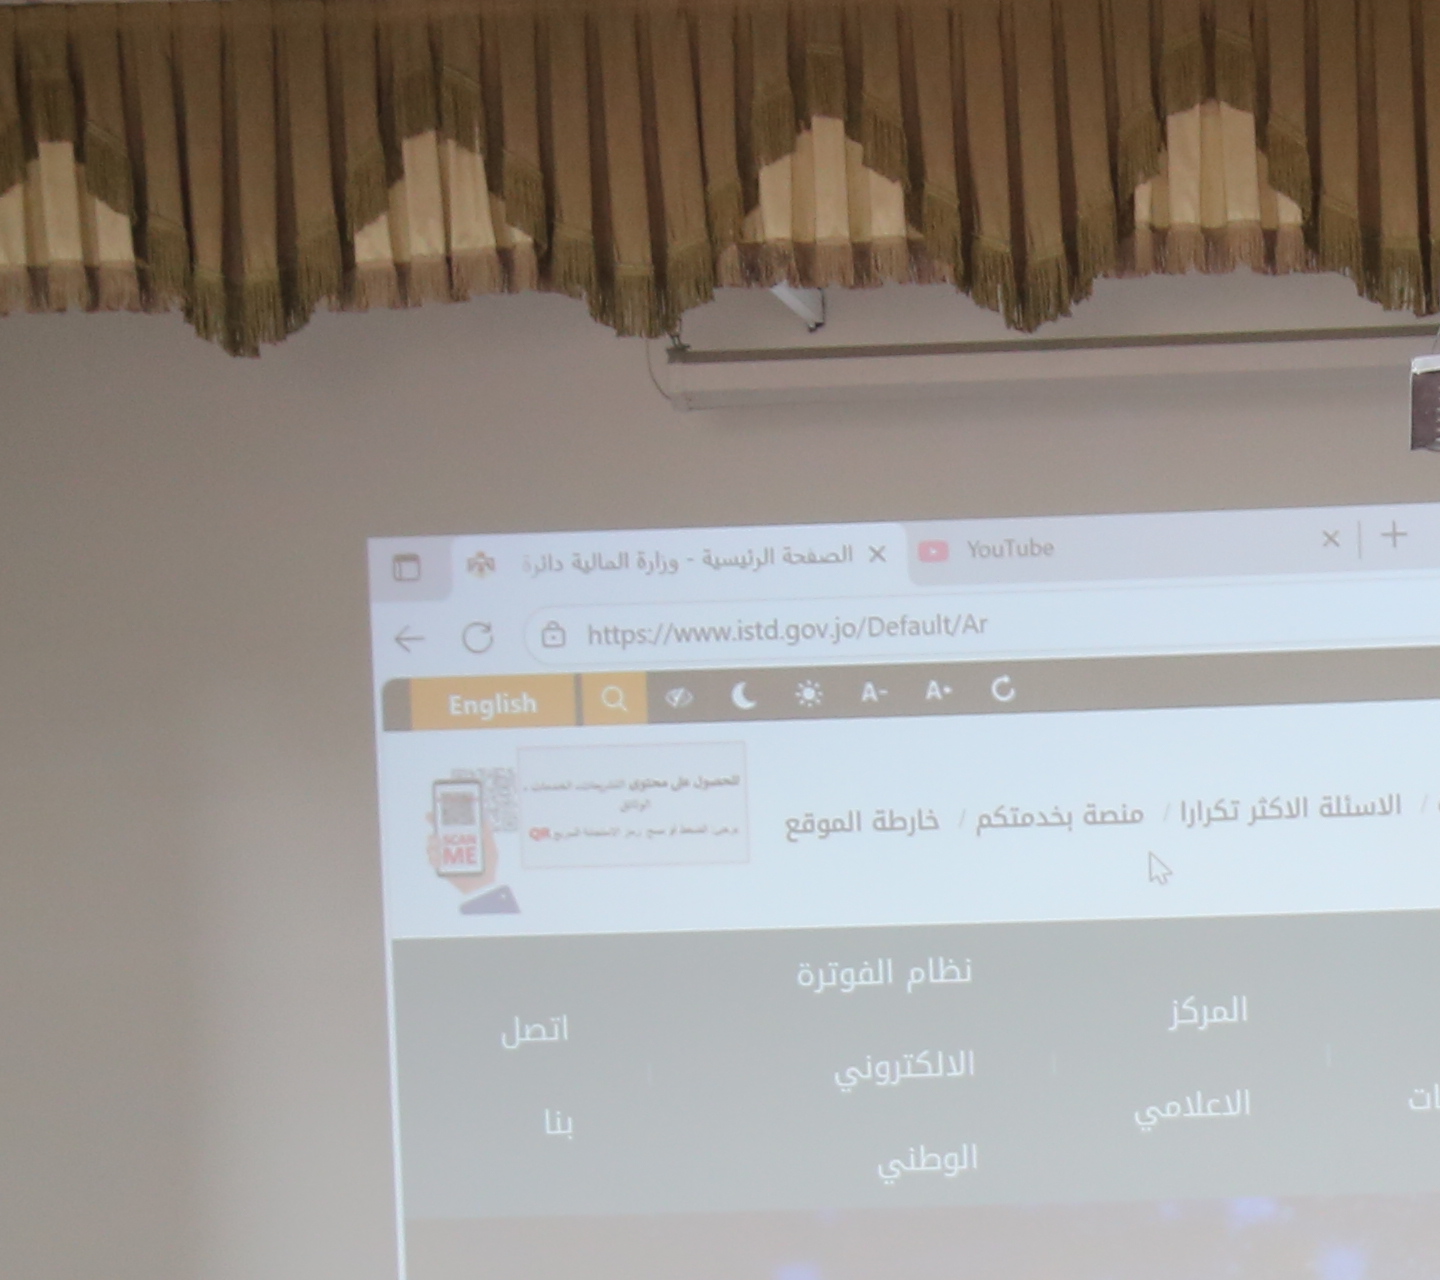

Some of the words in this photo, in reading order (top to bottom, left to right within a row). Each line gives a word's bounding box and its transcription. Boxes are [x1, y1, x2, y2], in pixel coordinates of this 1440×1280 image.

[571, 551, 630, 574] المالية
[636, 553, 680, 575] وزارة
[702, 548, 775, 573] الرئيسية
[782, 544, 853, 568] الصفحة
[966, 536, 1055, 560] YouTube
[587, 611, 988, 650] https://www.istd.gov.jo/Default/Ar
[448, 692, 538, 719] English
[871, 806, 941, 836] خارطة
[975, 804, 1073, 837] بخدمتكم
[1083, 802, 1144, 827] منصة
[1179, 799, 1240, 827] تكرارا
[1247, 796, 1310, 828] الاكثر
[1318, 794, 1403, 820] الاسئلة
[784, 809, 862, 843] الموقع
[442, 847, 477, 865] ME
[796, 957, 895, 996] الفوترة
[905, 954, 975, 995] نظام
[1167, 994, 1250, 1031] المركز
[500, 1016, 571, 1051] اتصل
[833, 1050, 977, 1092] الالكتروني
[543, 1106, 575, 1140] بنا
[1133, 1088, 1252, 1132] الاعلامي
[876, 1143, 980, 1185] الوطني
